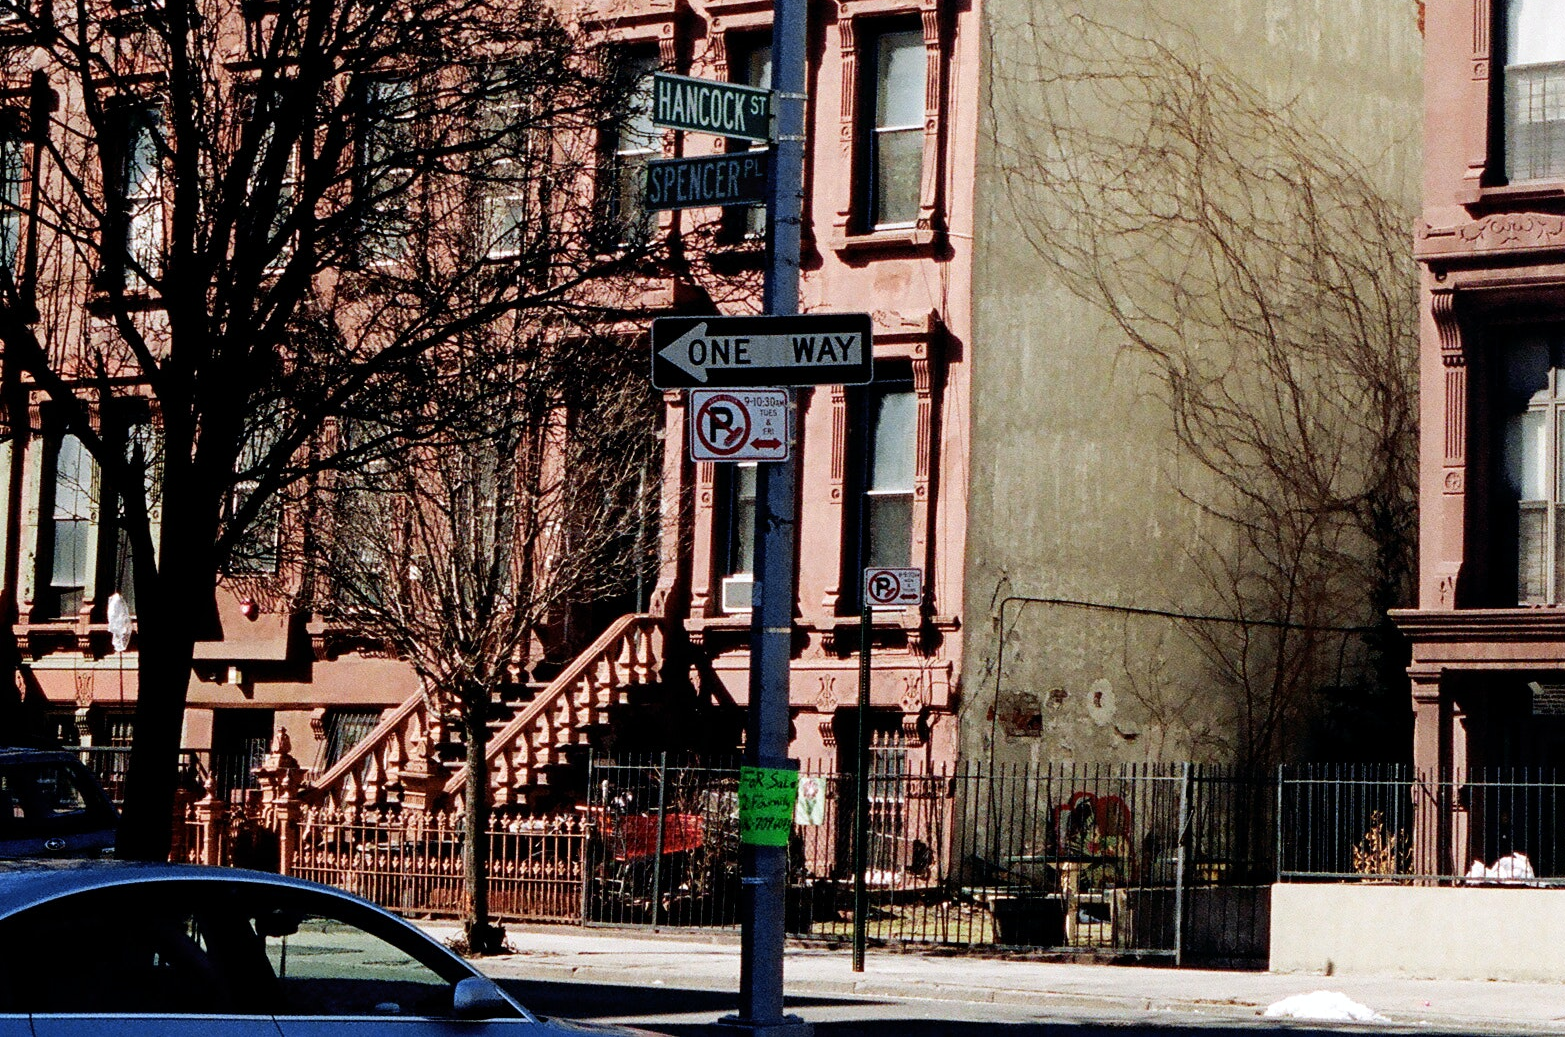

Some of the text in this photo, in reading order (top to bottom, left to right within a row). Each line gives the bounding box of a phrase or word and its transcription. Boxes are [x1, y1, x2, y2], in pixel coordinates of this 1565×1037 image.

[659, 81, 767, 132] HANCOCK ST
[650, 159, 763, 204] SPENCER PL
[688, 335, 855, 366] ONE WAY
[760, 408, 778, 417] TUES
[762, 427, 775, 435] FRI
